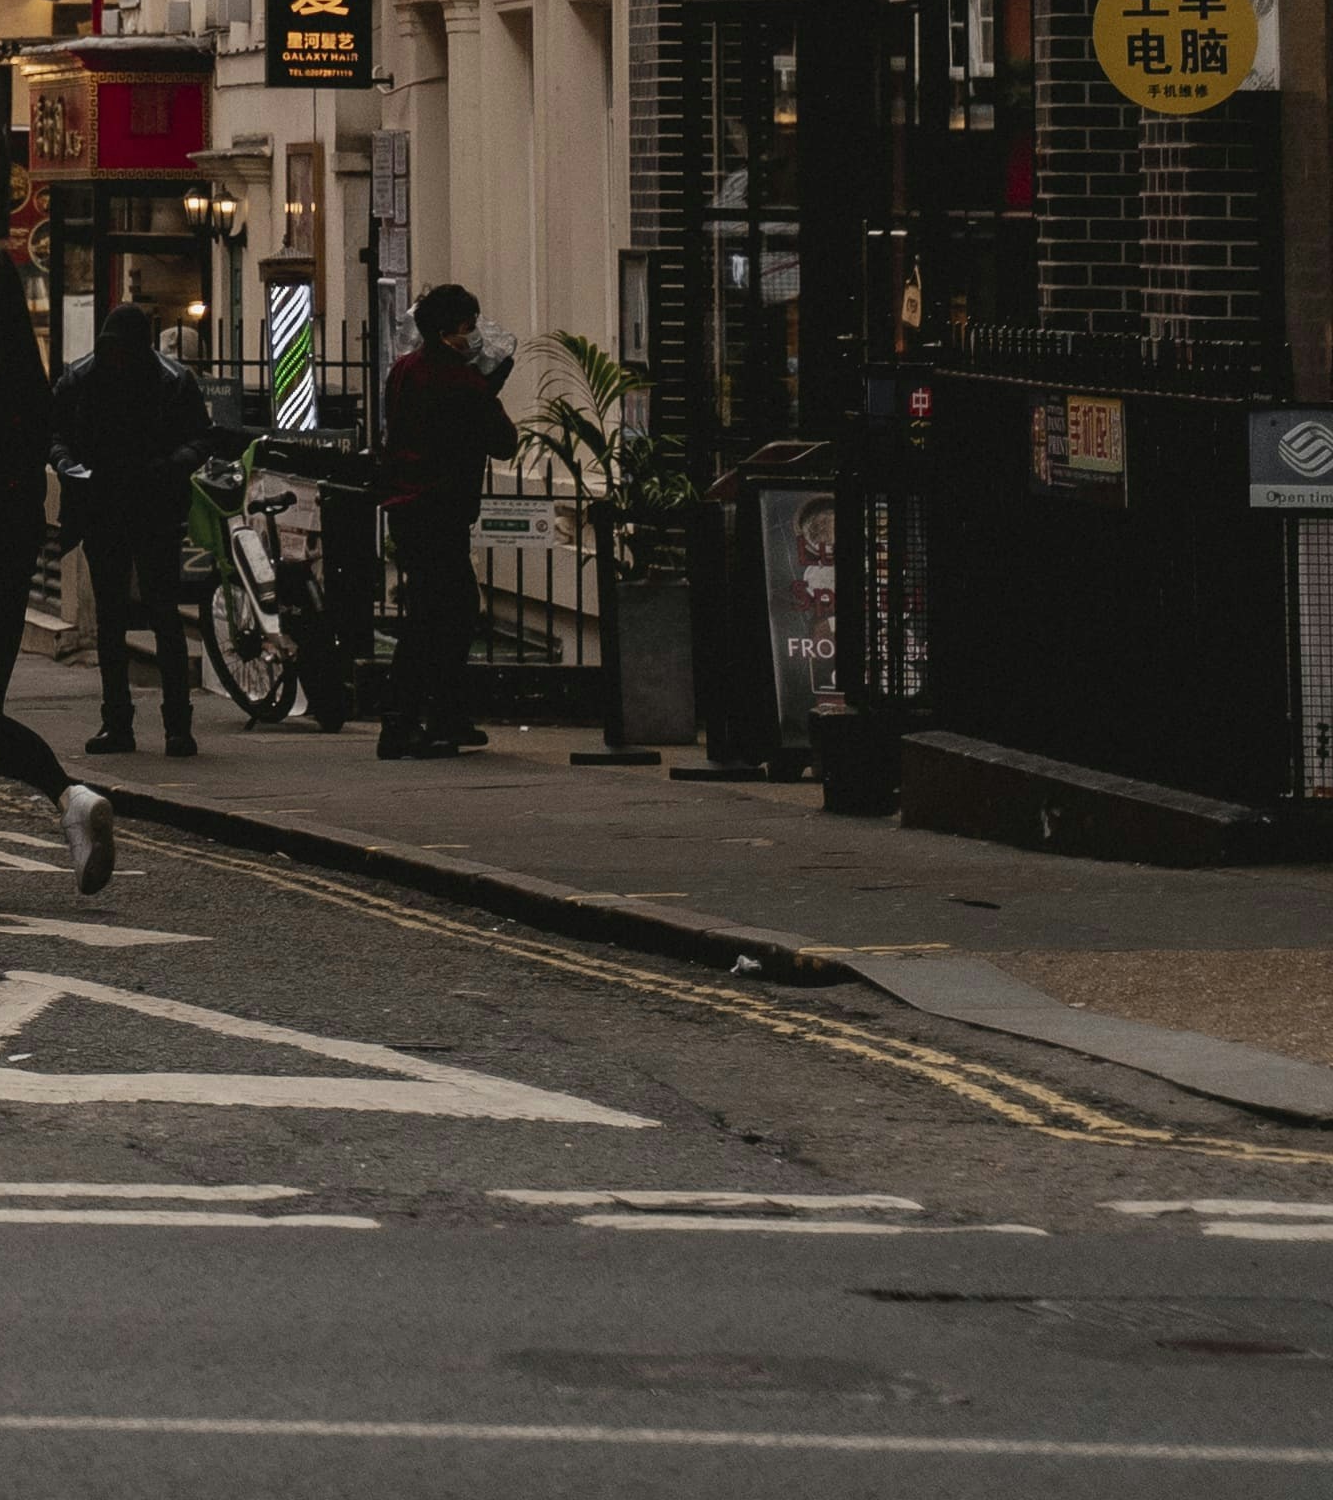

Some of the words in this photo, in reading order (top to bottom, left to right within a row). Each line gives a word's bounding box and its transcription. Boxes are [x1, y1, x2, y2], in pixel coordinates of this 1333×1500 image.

[282, 52, 328, 62] GALAXY
[330, 52, 358, 63] HAIR
[1127, 28, 1229, 75] 电脑
[1148, 84, 1208, 98] 手机维修
[1266, 490, 1305, 506] Open
[788, 638, 836, 659] FRO
